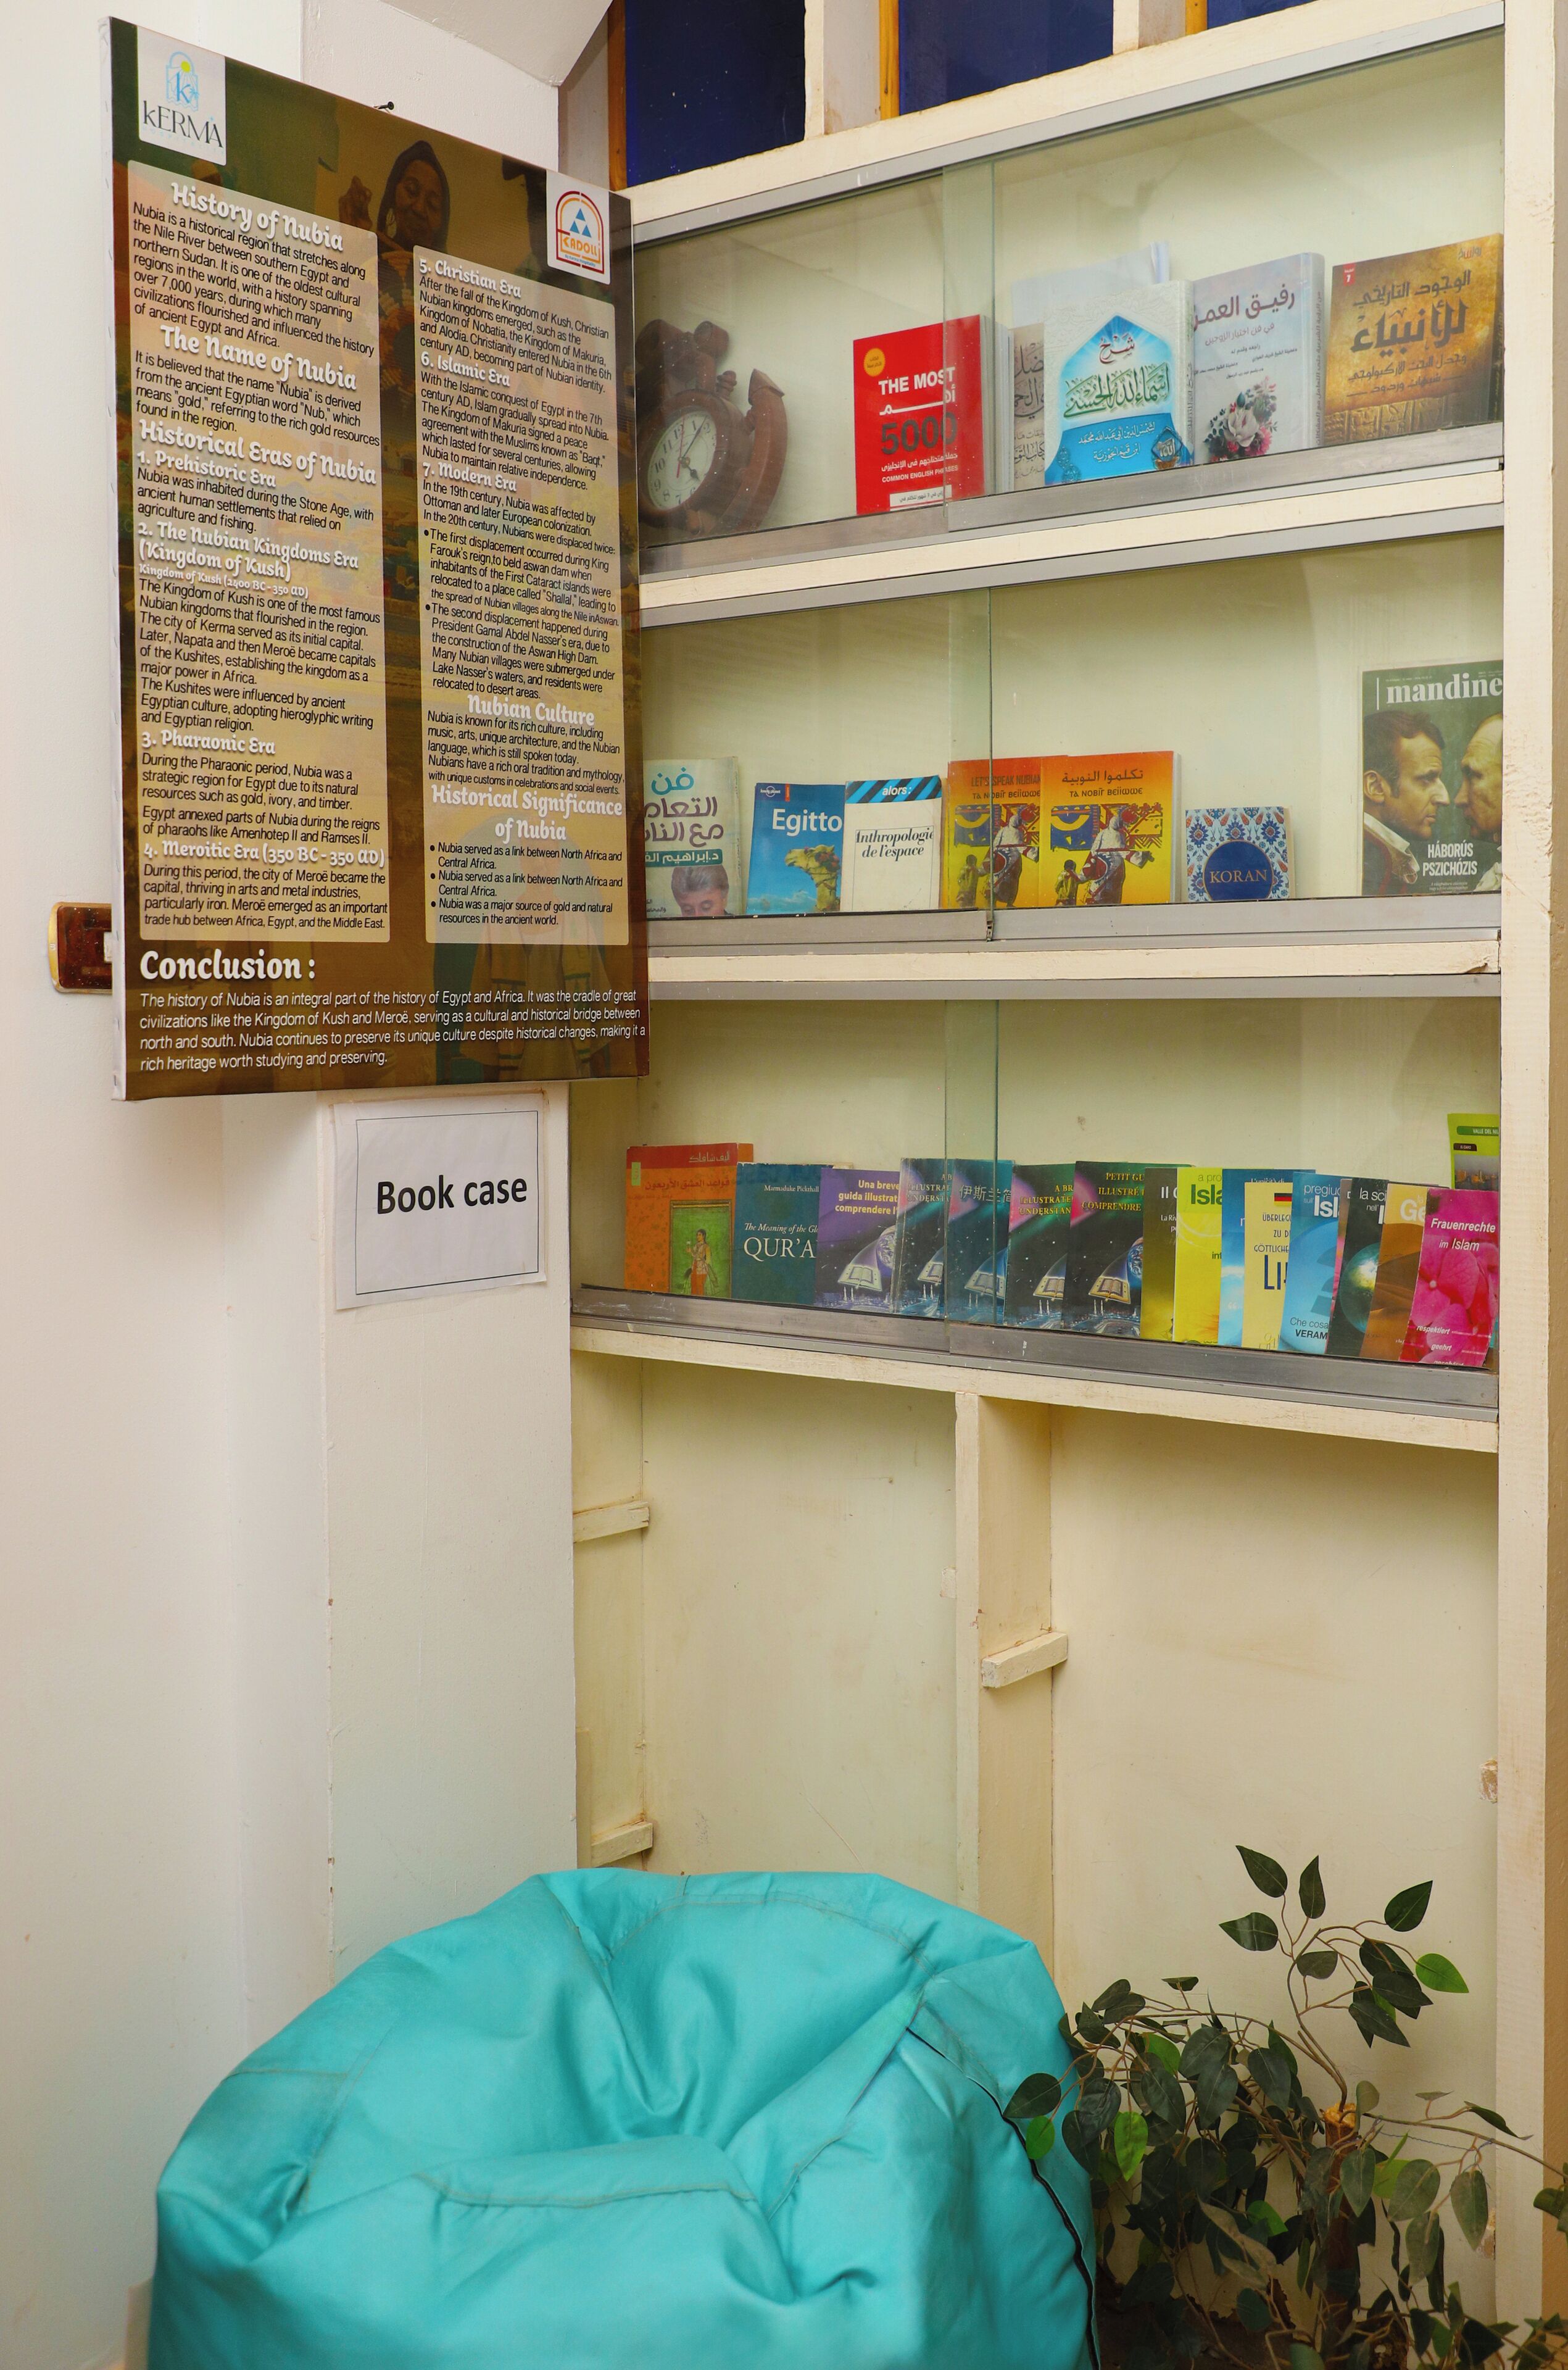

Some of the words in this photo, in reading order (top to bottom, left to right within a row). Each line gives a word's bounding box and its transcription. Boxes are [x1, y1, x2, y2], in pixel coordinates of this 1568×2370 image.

[171, 181, 253, 232] History
[257, 210, 279, 240] of
[283, 214, 344, 252] Nubia
[133, 202, 165, 223] Nubia
[168, 210, 177, 225] is
[180, 217, 186, 228] a
[189, 217, 235, 242] historical
[238, 233, 269, 251] region
[272, 241, 291, 257] that
[293, 247, 338, 271] stretches
[341, 262, 365, 280] along
[419, 258, 432, 276] 5.
[435, 258, 497, 293] Christian
[499, 278, 521, 299] Era
[1414, 269, 1472, 297] الوجود
[1245, 283, 1295, 320] رفيق
[1353, 281, 1410, 309] التاريخي
[1193, 294, 1239, 332] العمر
[160, 325, 199, 355] The
[204, 335, 266, 370] Name
[271, 352, 294, 383] of
[296, 357, 357, 391] Nubia
[420, 351, 434, 368] 6.
[438, 355, 486, 381] Islamic
[488, 368, 510, 388] Era
[878, 376, 909, 395] THE
[914, 367, 955, 391] MOST
[881, 412, 958, 455] 5000
[139, 418, 245, 459] Historical
[249, 443, 292, 469] Eras
[296, 451, 317, 479] of
[319, 455, 377, 485] Nubia
[137, 451, 151, 465] 1.
[155, 451, 247, 483] Prehistoric
[250, 468, 276, 488] Era
[422, 462, 436, 477] 7.
[438, 462, 492, 488] Modern
[494, 474, 516, 493] Era
[882, 474, 908, 483] COMMON
[910, 470, 934, 478] ENGLISH
[138, 523, 153, 538] 2.
[157, 522, 187, 542] The
[190, 527, 250, 552] Nubian
[253, 536, 331, 565] Kingdoms
[333, 551, 359, 570] Era
[139, 538, 222, 570] (Kingdom
[225, 557, 241, 577] of
[245, 557, 292, 582] Kush)
[1386, 672, 1503, 704] mandine
[467, 694, 532, 721] Nubian
[535, 702, 595, 726] Culture
[141, 732, 157, 748] 3.
[160, 729, 246, 753] Pharaonic
[249, 736, 276, 755] Era
[651, 767, 694, 796] فن
[992, 775, 1014, 786] SPEAK
[1061, 770, 1100, 785] النوبية
[1104, 768, 1143, 784] تكلموا
[431, 784, 518, 810] Historical
[521, 791, 623, 819] Significance
[495, 817, 513, 845] of
[516, 820, 566, 841] Nubia
[771, 808, 843, 837] Egitto
[689, 823, 724, 847] مع
[143, 842, 159, 859] 4.
[162, 840, 231, 860] Meroitic
[233, 843, 260, 860] Era
[262, 843, 294, 865] (350
[297, 846, 318, 863] BC
[330, 852, 354, 868] 350
[357, 847, 386, 868] AD)
[861, 846, 877, 858] de
[879, 845, 924, 862] l'espace
[1428, 839, 1474, 858] HÁBORÚS
[144, 865, 180, 879] During
[183, 865, 201, 878] this
[204, 868, 241, 881] period,
[243, 868, 260, 879] the
[262, 868, 280, 883] city
[283, 868, 292, 881] of
[296, 869, 328, 883] Meroë
[330, 871, 368, 884] became
[371, 872, 386, 884] the
[1209, 869, 1267, 883] KORAN
[1422, 858, 1477, 876] PSZICHÓZIS
[439, 913, 480, 925] resources
[482, 913, 489, 923] in
[491, 913, 503, 924] the
[505, 914, 533, 925] ancient
[534, 915, 558, 925] world.
[140, 949, 302, 980] Conclusion
[140, 1057, 164, 1071] rich
[167, 1056, 217, 1072] heritage
[219, 1055, 253, 1068] worth
[256, 1054, 303, 1070] studying
[306, 1052, 326, 1065] and
[330, 1051, 388, 1067] preserving.
[764, 1184, 796, 1192] Marmaduke
[858, 1179, 876, 1189] Una
[877, 1181, 899, 1190] breve
[1106, 1173, 1130, 1181] PETIT
[1132, 1173, 1145, 1182] GU
[378, 1174, 455, 1214] Book
[463, 1178, 527, 1207] case
[839, 1192, 862, 1202] guida
[865, 1193, 898, 1202] illustrat
[1098, 1186, 1139, 1196] ILLUSTRÉ
[1190, 1184, 1222, 1205] Isla
[1359, 1187, 1369, 1200] la
[1371, 1190, 1387, 1201] sci
[835, 1205, 891, 1215] comprendere
[1082, 1201, 1141, 1212] COMPRENDRE
[1400, 1199, 1425, 1222] Ge
[744, 1223, 756, 1231] The
[758, 1223, 787, 1233] Meaning
[788, 1224, 796, 1234] of
[797, 1224, 807, 1233] the
[1274, 1229, 1282, 1237] ZU
[1430, 1218, 1496, 1233] Frauenrechte
[744, 1237, 816, 1262] QUR'A
[1254, 1244, 1288, 1253] GÖTTLICHE
[1438, 1240, 1449, 1249] im
[1451, 1238, 1480, 1252] Islam
[1290, 1317, 1308, 1326] Che
[1309, 1320, 1329, 1329] cosa
[1295, 1329, 1327, 1340] VERAM
[1416, 1326, 1450, 1334] respektiert
